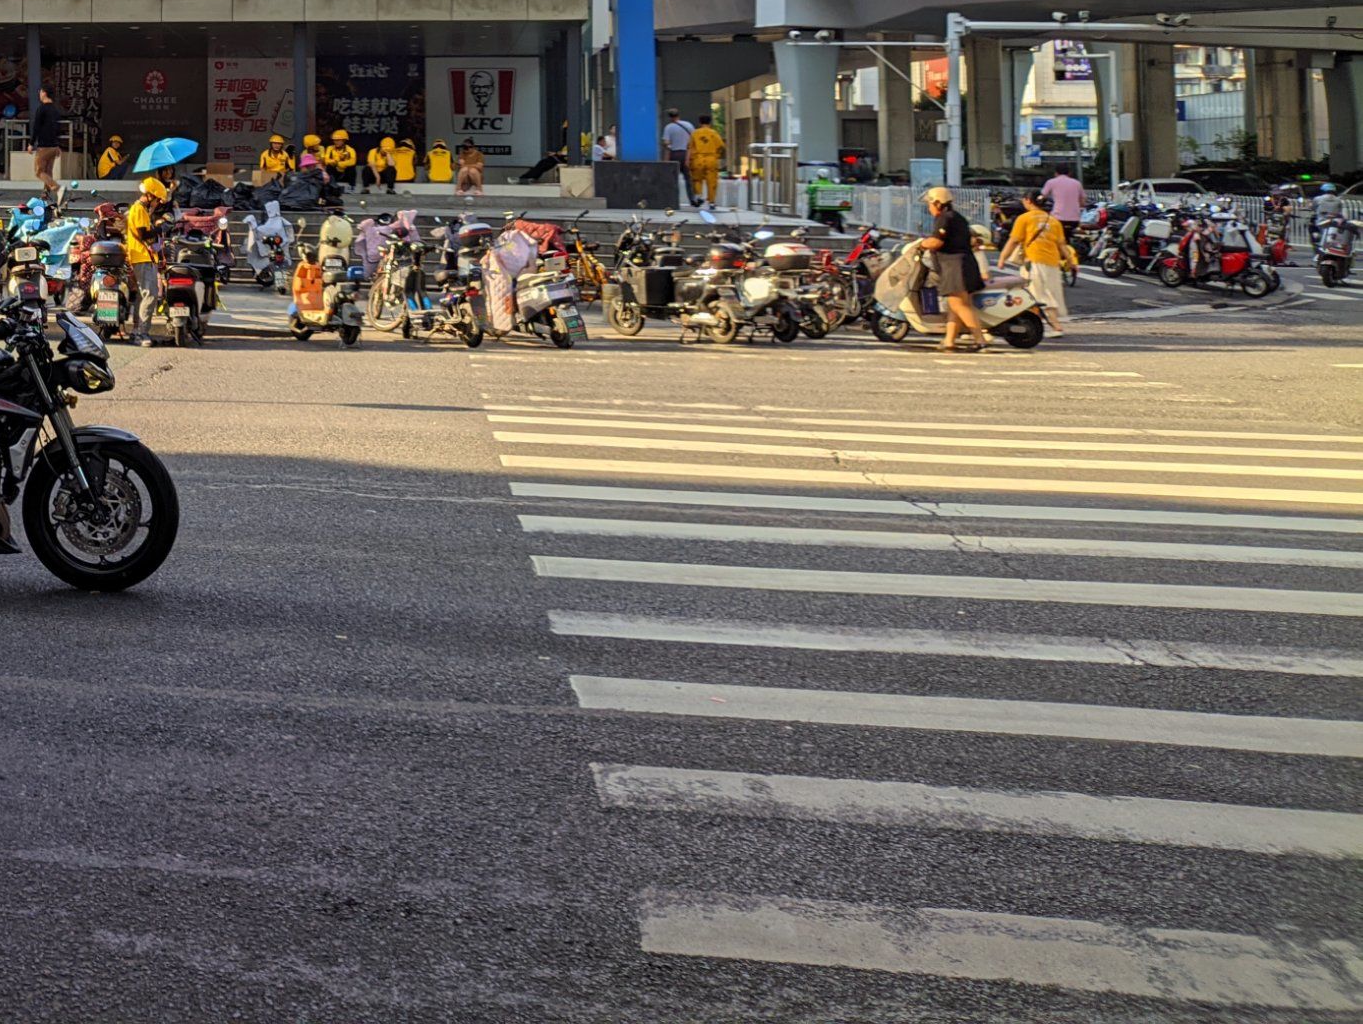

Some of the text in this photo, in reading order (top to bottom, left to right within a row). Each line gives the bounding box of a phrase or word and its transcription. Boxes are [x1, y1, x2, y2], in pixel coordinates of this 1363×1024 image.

[213, 79, 269, 93] 手机回收
[213, 98, 229, 113] 来
[332, 97, 408, 116] 吃蛙就吃
[213, 118, 269, 133] 转转门店
[462, 117, 504, 131] KFC
